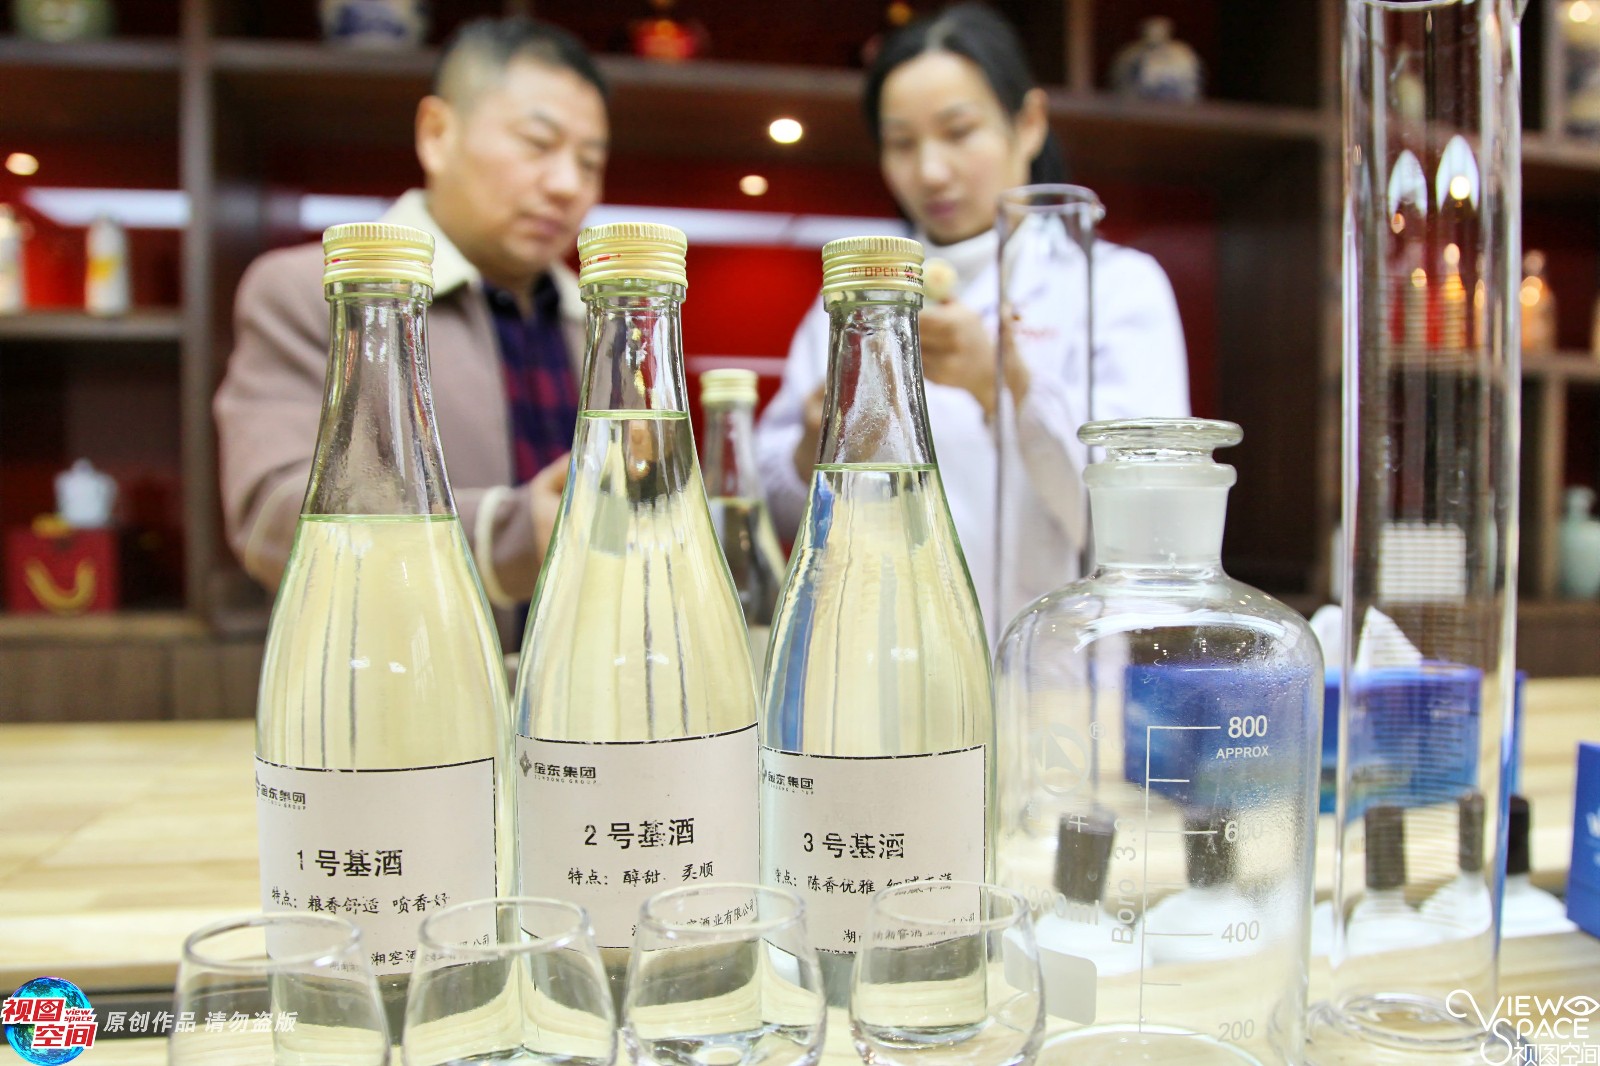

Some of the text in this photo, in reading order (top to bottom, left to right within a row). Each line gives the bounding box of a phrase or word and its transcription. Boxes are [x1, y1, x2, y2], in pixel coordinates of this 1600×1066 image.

[864, 266, 899, 277] OPEN
[1228, 715, 1268, 738] 800
[1215, 745, 1269, 760] APPROX
[1224, 820, 1264, 843] 600
[296, 849, 403, 877] 1号基酒
[1111, 879, 1137, 945] Boro
[1221, 920, 1260, 943] 400
[1217, 1019, 1255, 1043] 200
